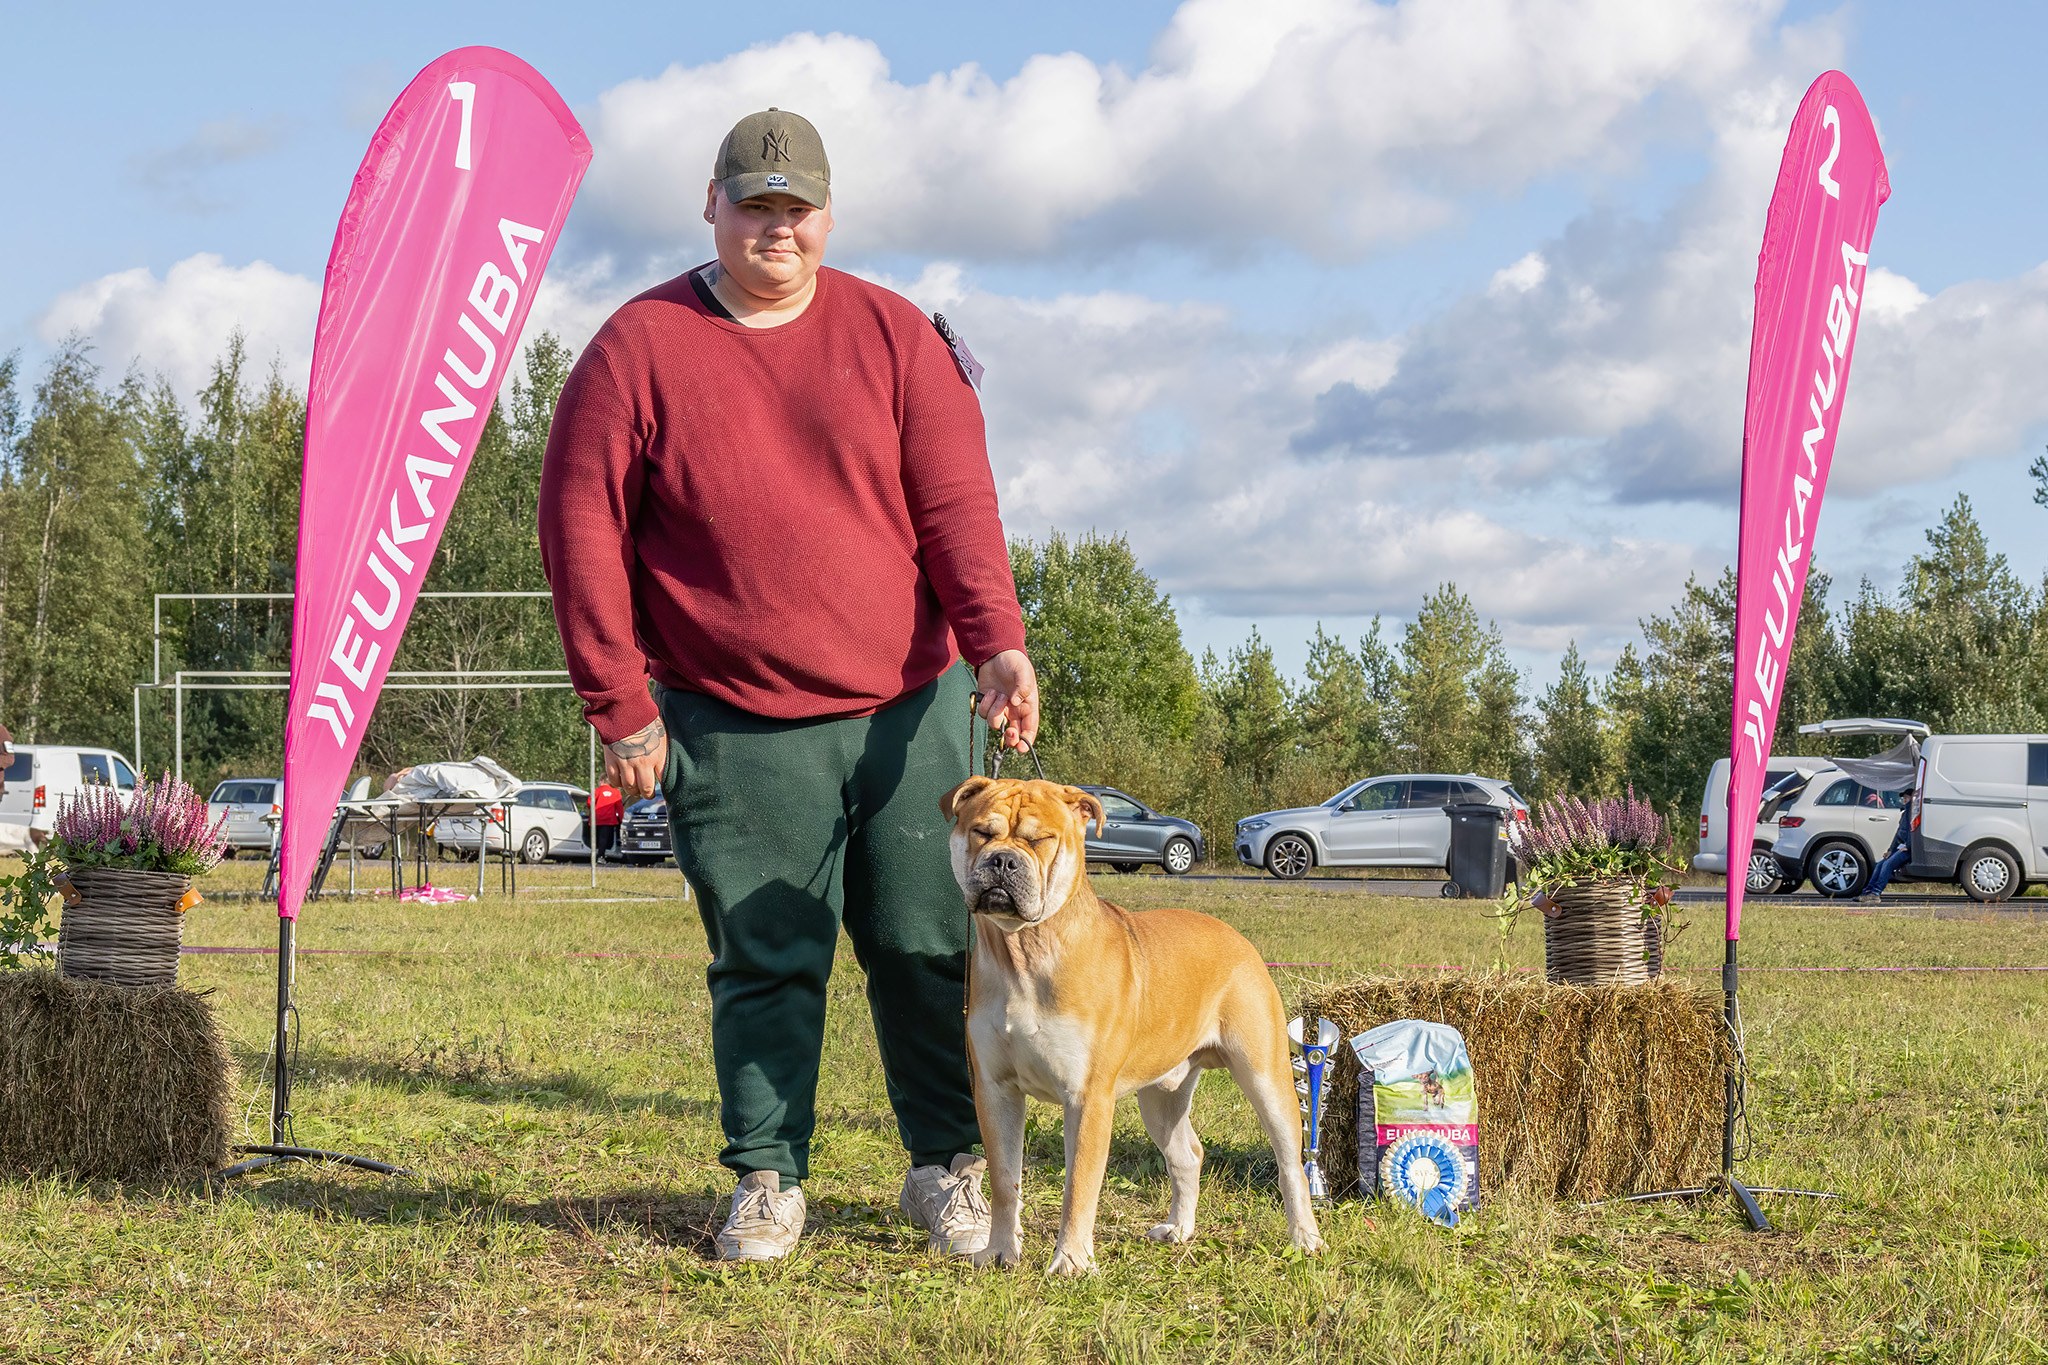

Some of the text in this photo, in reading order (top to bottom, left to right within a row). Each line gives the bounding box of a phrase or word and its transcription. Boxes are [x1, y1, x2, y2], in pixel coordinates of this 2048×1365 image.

[447, 81, 476, 171] 1
[1818, 104, 1841, 200] 2
[329, 217, 545, 692] EUKANUBA
[1754, 240, 1869, 710] EUKANUBA
